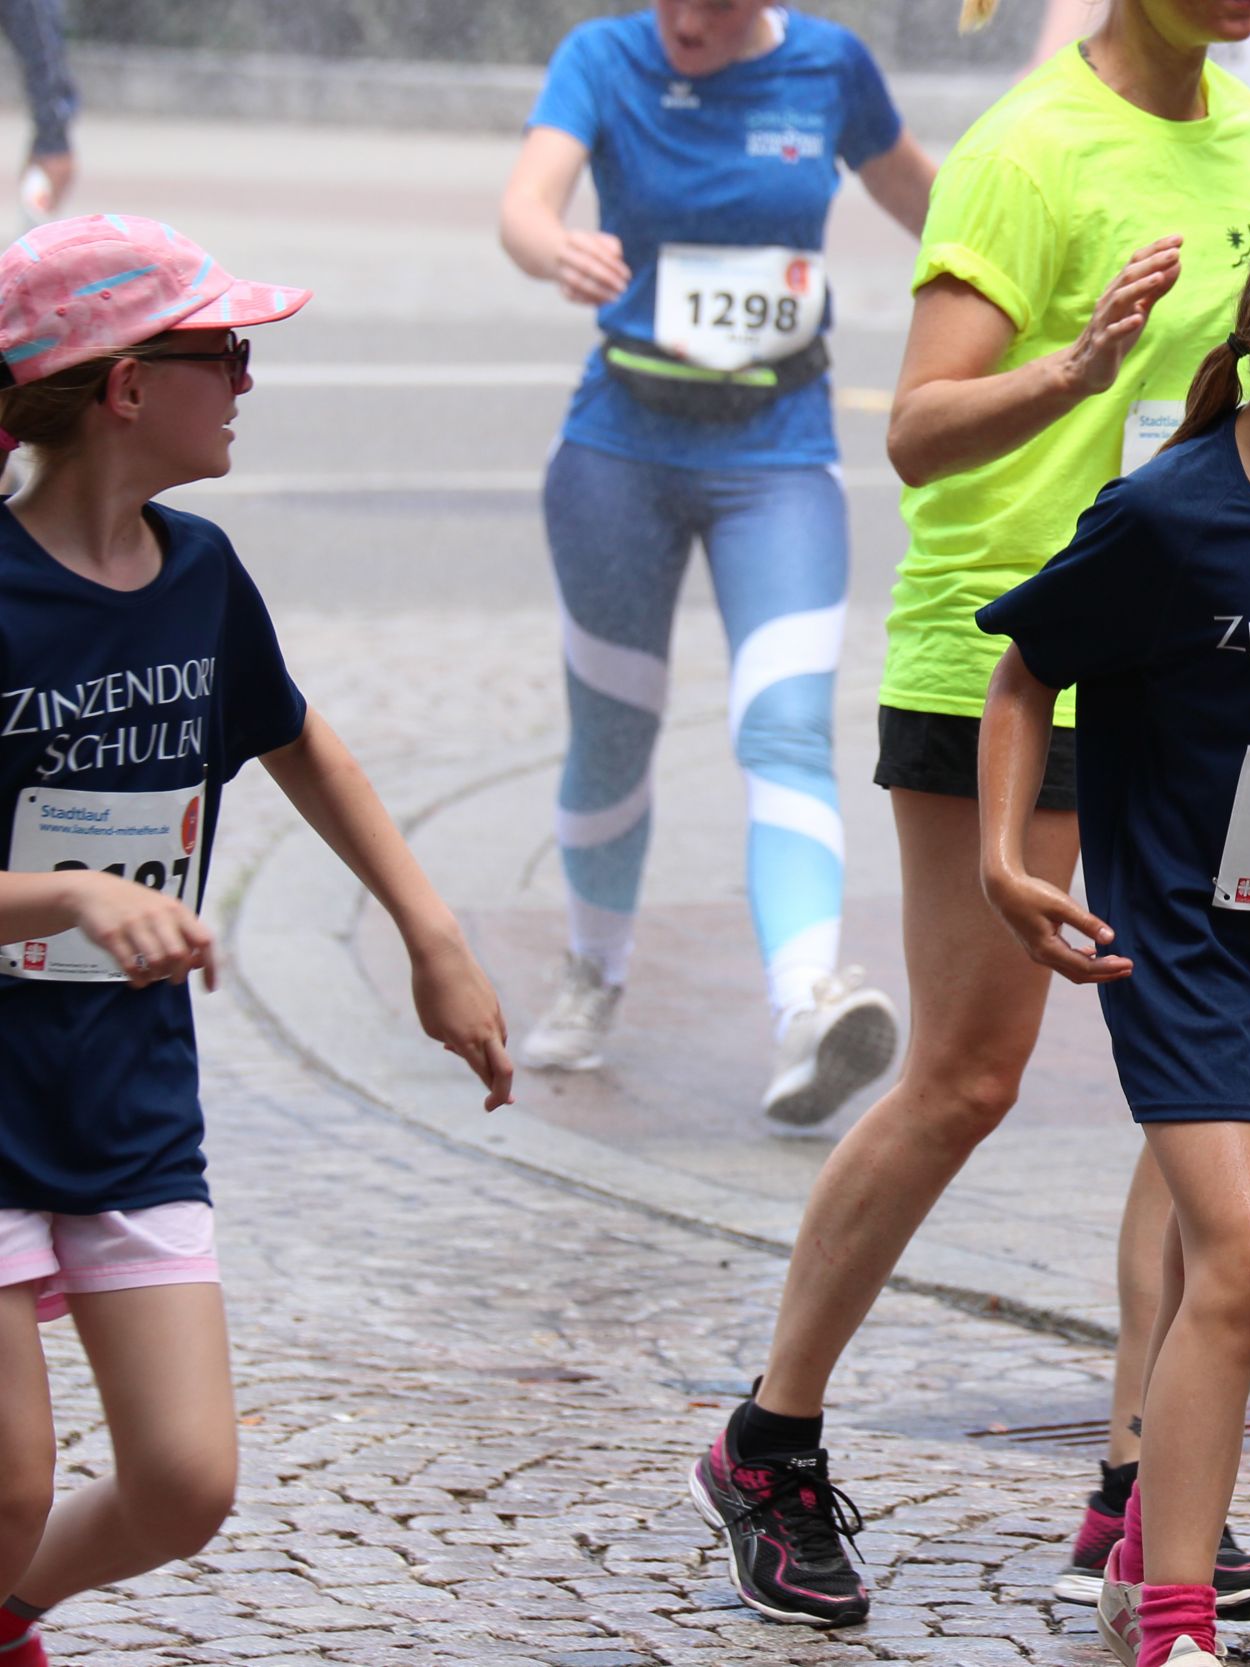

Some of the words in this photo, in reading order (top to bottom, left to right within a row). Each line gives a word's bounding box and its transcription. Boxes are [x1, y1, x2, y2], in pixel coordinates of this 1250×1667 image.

[687, 291, 798, 333] 1298
[36, 716, 202, 778] SCHULEN
[41, 804, 110, 822] Stadtlauf
